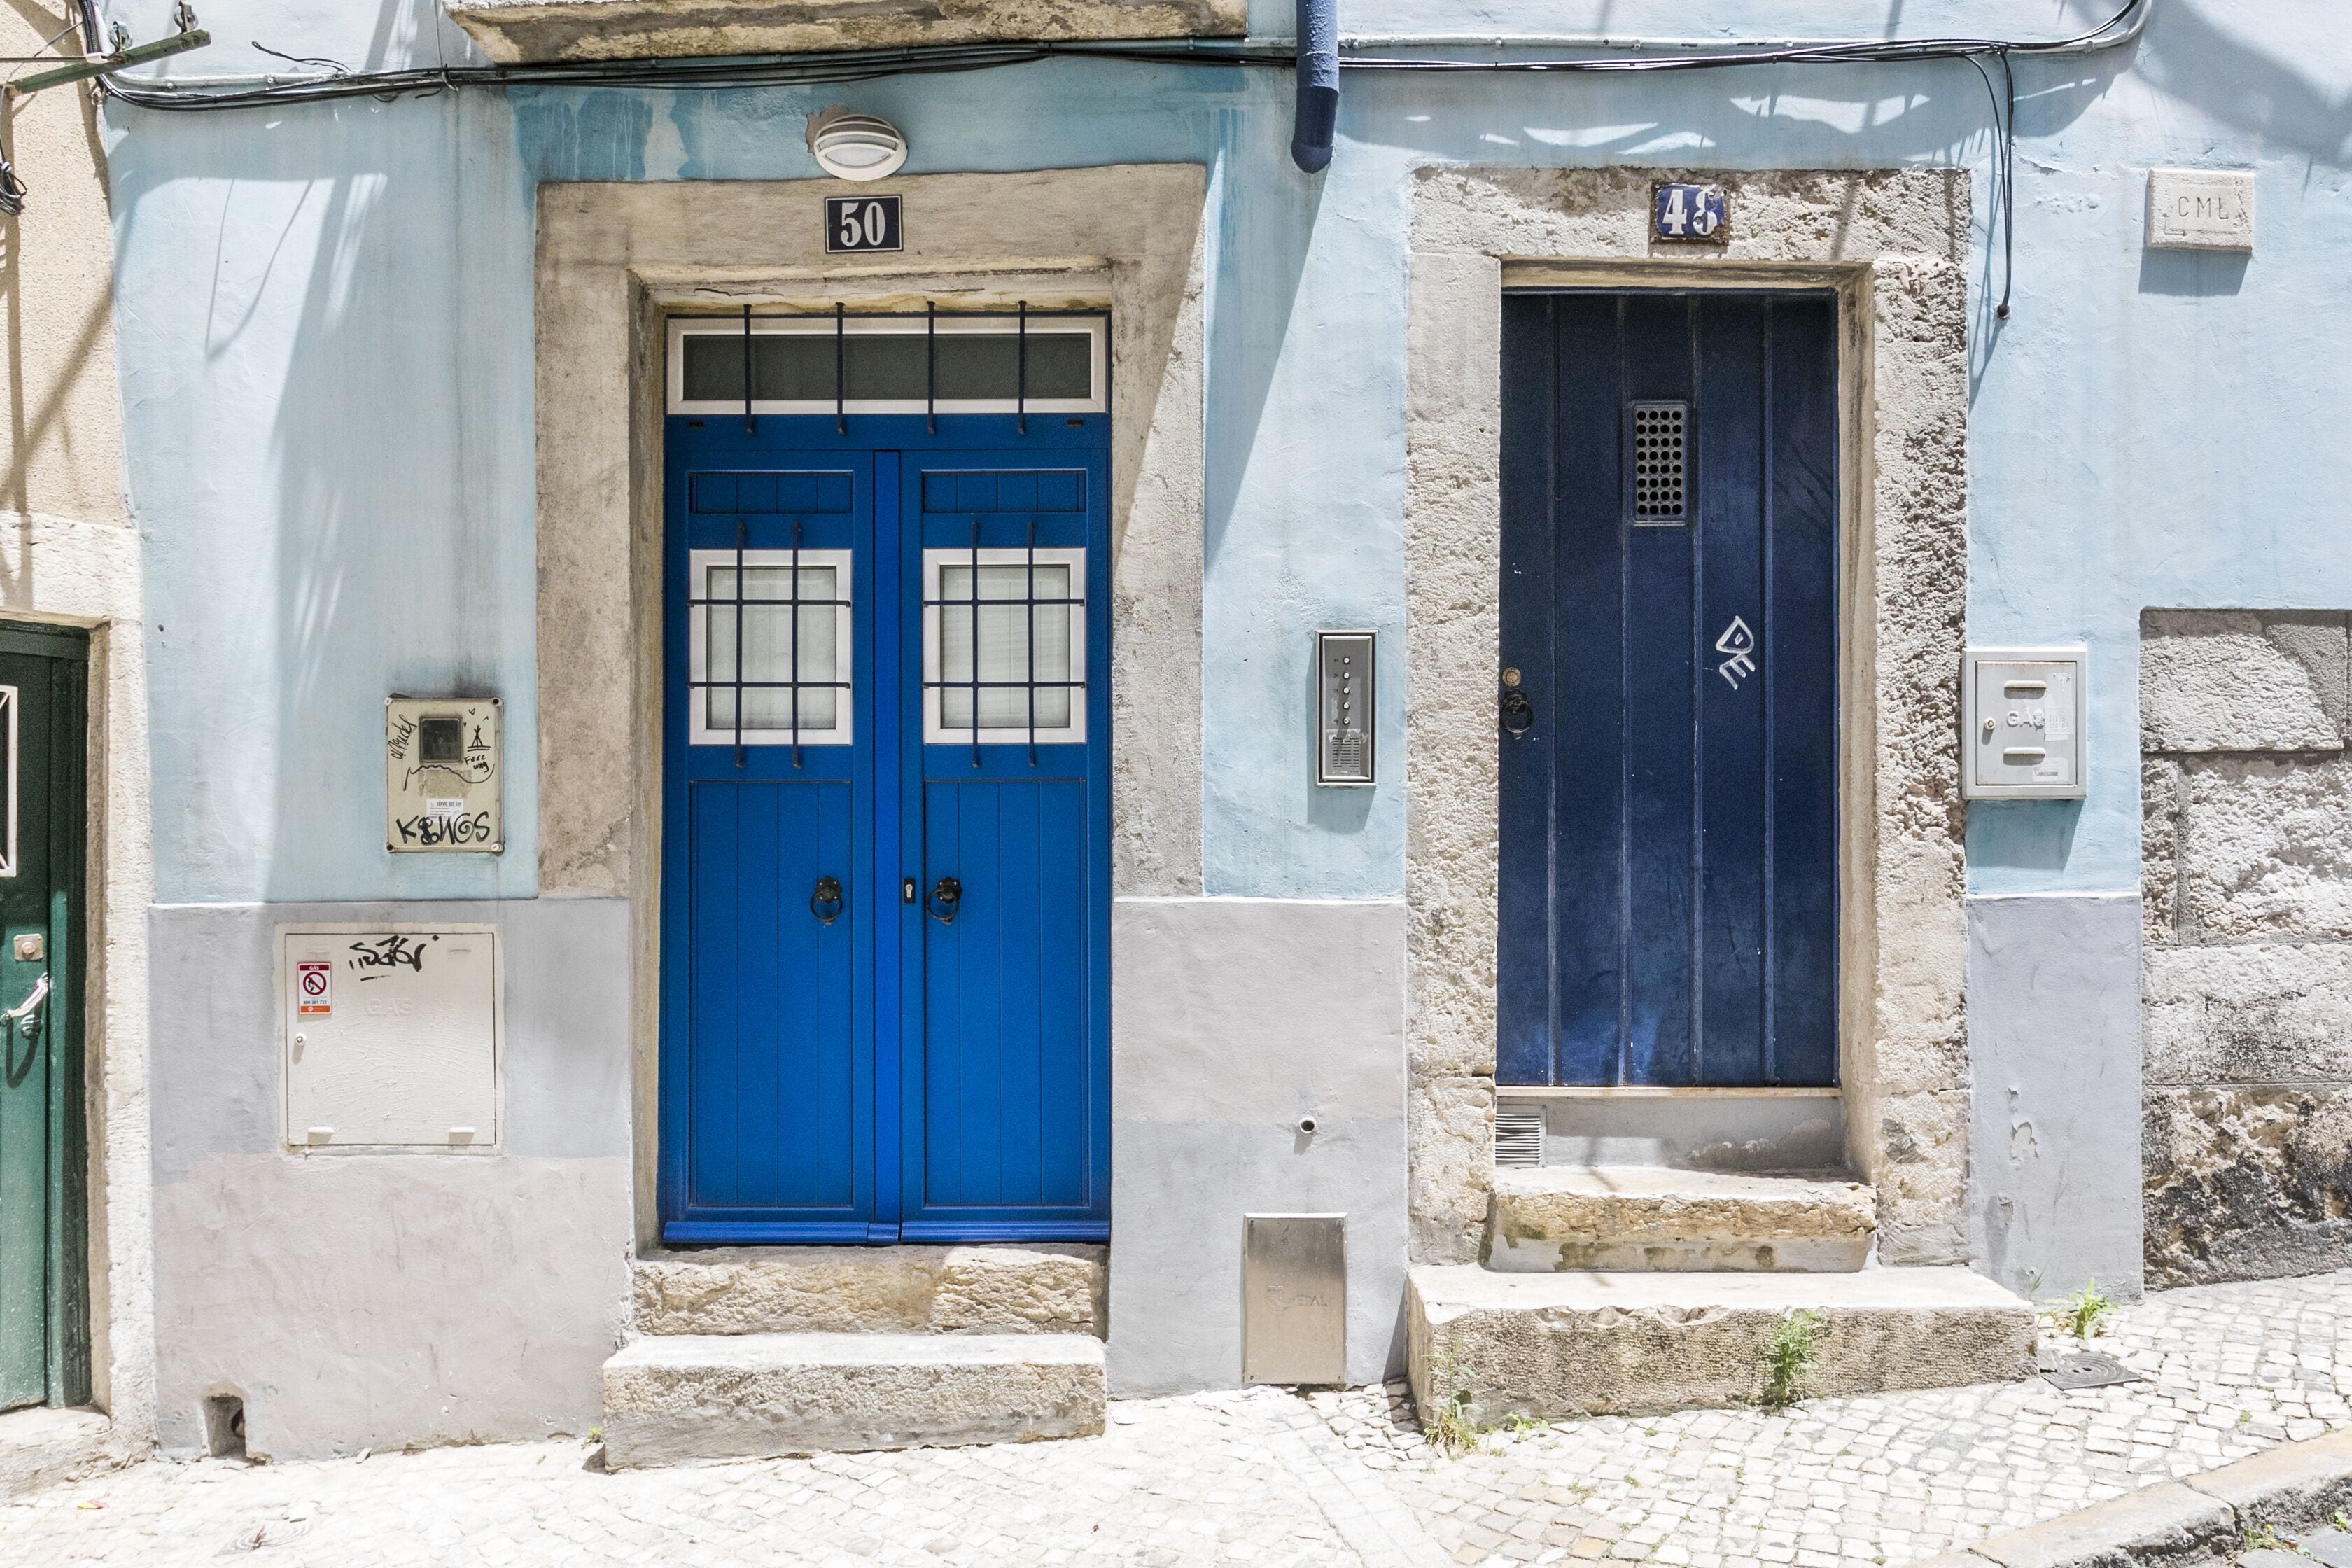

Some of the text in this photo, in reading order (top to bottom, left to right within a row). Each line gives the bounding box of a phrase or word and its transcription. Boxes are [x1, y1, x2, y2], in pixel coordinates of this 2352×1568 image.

[2178, 196, 2229, 220] CML
[840, 202, 886, 246] 50
[1296, 1294, 1328, 1307] EPAL
